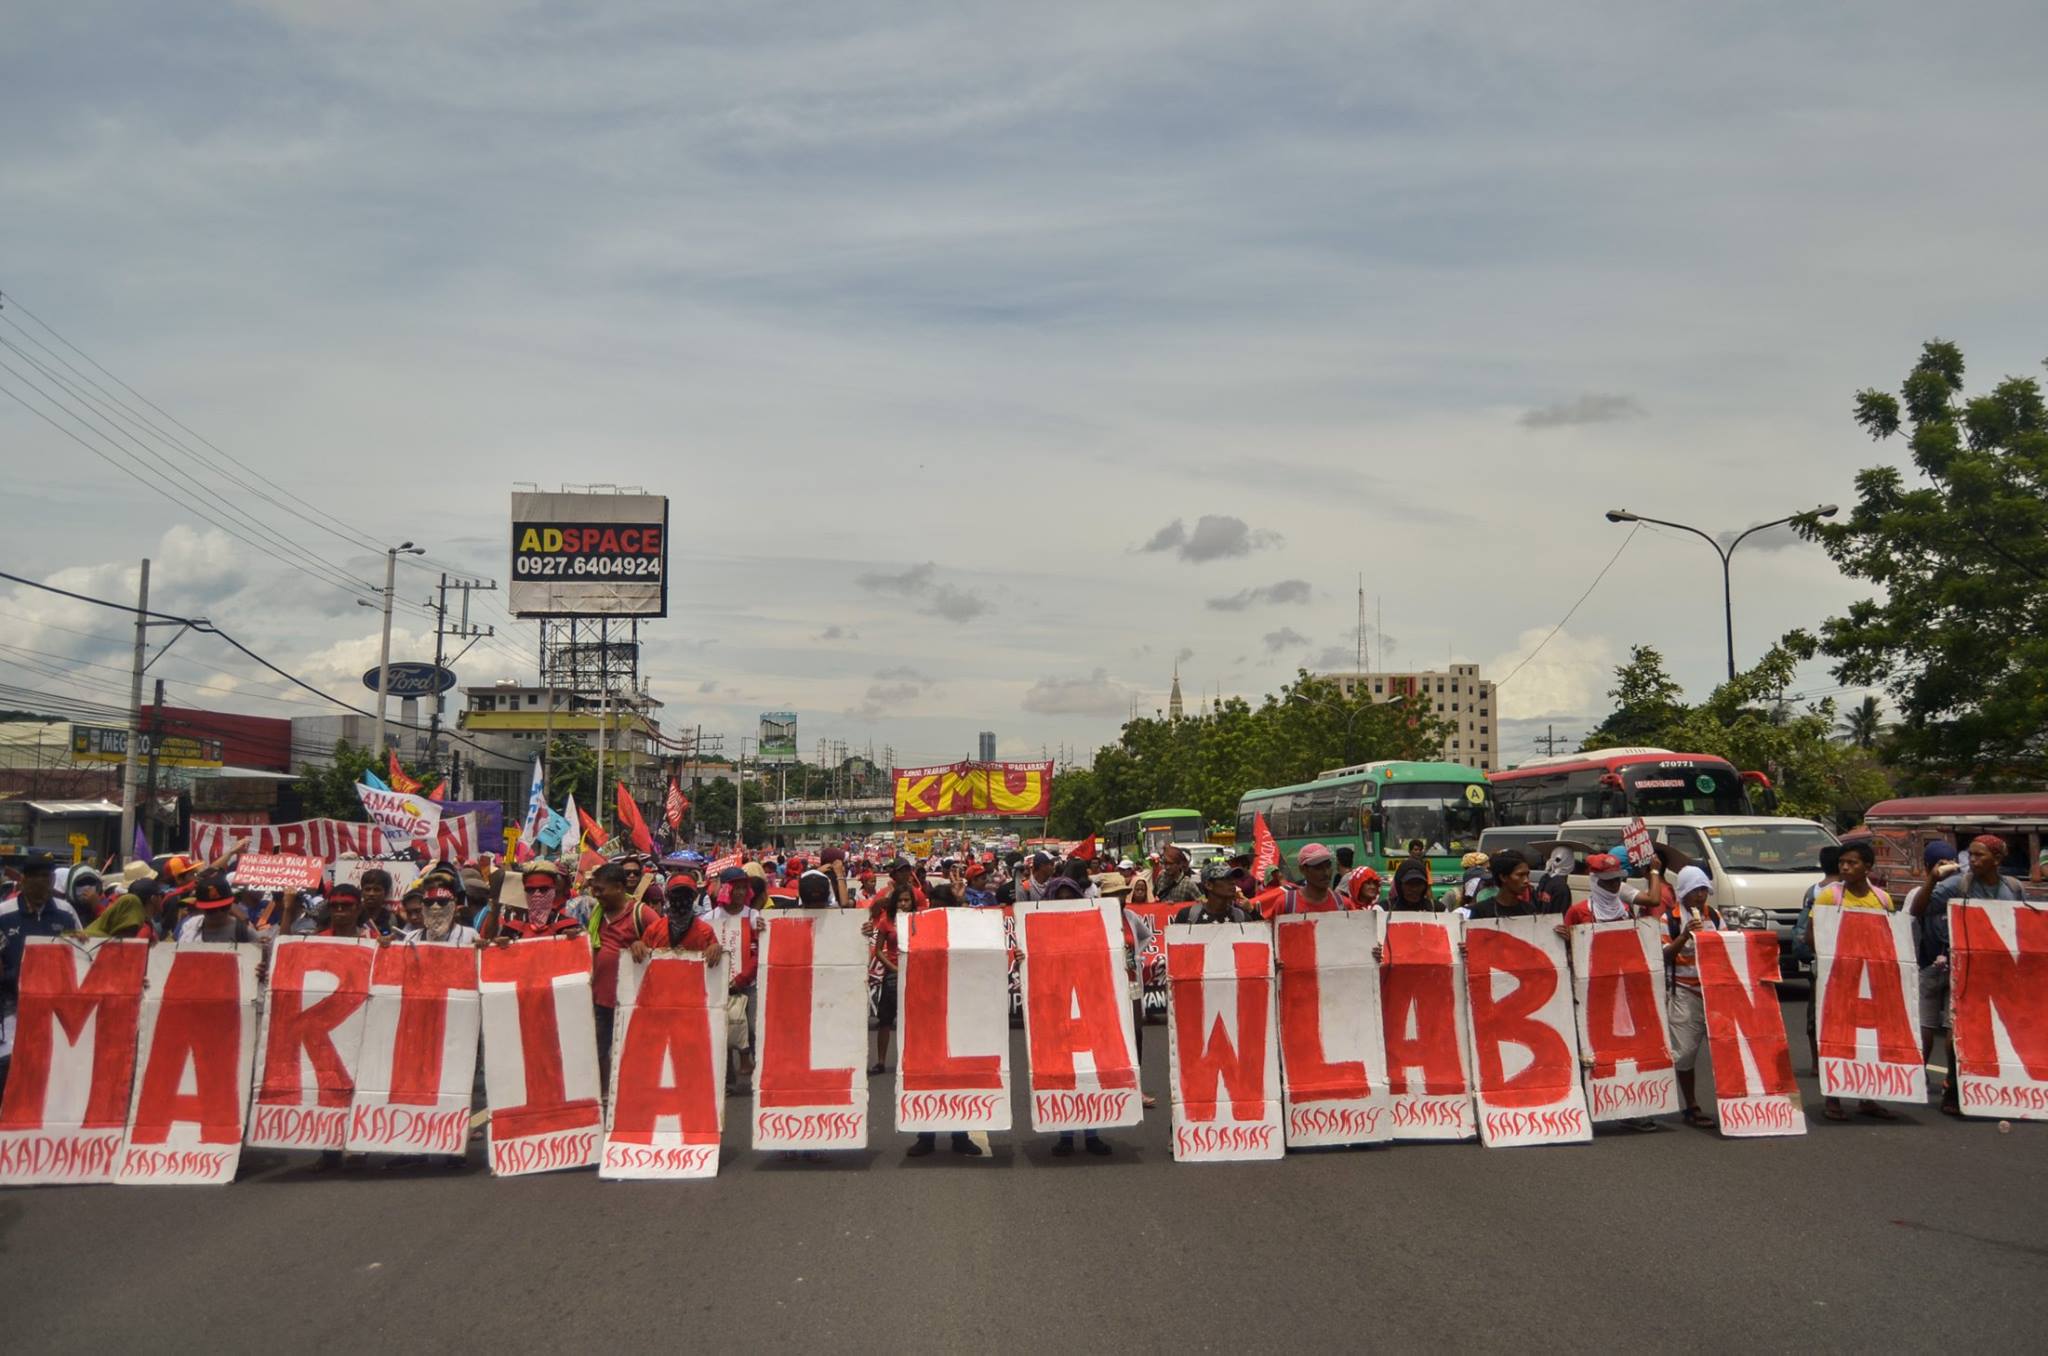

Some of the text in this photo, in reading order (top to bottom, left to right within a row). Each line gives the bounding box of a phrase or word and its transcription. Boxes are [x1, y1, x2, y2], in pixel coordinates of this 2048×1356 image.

[520, 528, 660, 553] ADSPACE
[517, 556, 660, 576] 0927.6404924
[386, 667, 434, 690] Ford
[895, 770, 1042, 817] KMU
[1471, 789, 1480, 799] A
[1825, 1058, 1918, 1096] KADAMAY
[901, 1094, 1004, 1122] KADAMAY
[1036, 1092, 1131, 1123] KADAMAY
[1593, 1077, 1674, 1114] KADAMAY
[351, 1106, 469, 1151] KADAMAY
[758, 1113, 863, 1141] KADAMAY
[1290, 1104, 1384, 1137] KADAMAY
[1486, 1108, 1582, 1142] KADAMAY
[1720, 1102, 1794, 1130] KADAMAY
[494, 1132, 598, 1174] KADAMAY
[1176, 1124, 1276, 1156] KADAMAY
[0, 1135, 121, 1177] KADAMAY
[120, 1149, 231, 1178] KADAMAY
[605, 1147, 713, 1172] KADAMAY
